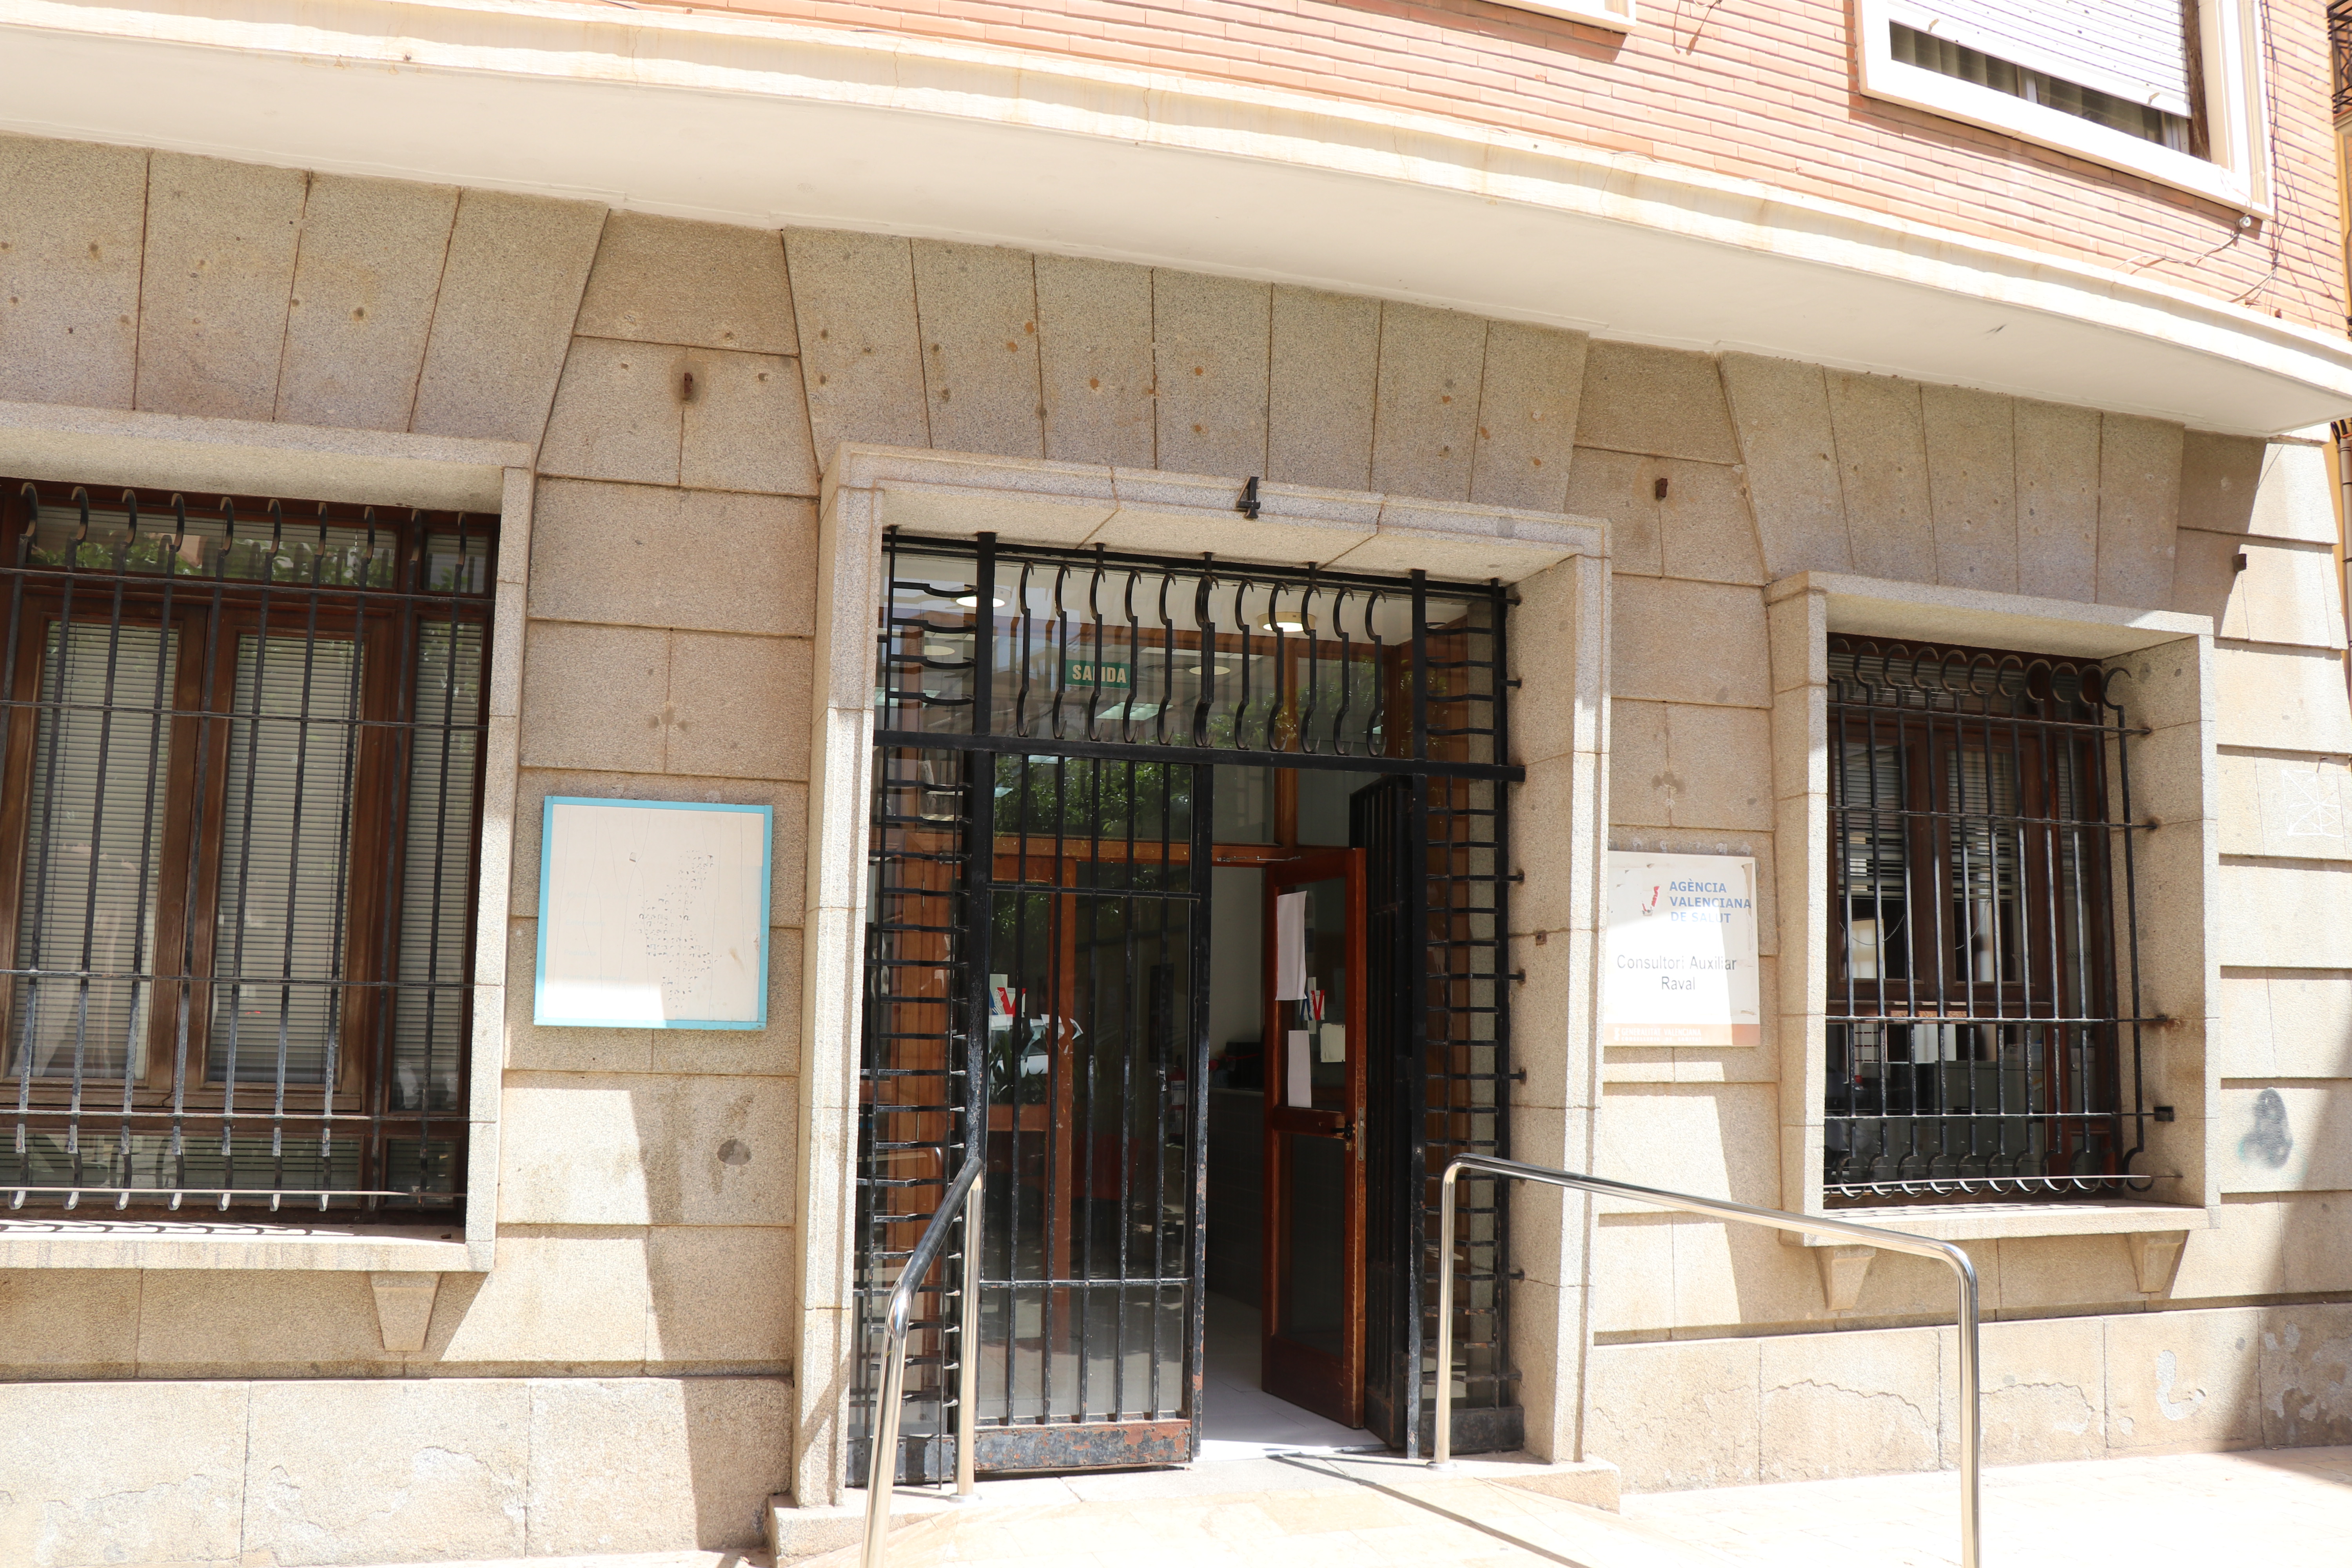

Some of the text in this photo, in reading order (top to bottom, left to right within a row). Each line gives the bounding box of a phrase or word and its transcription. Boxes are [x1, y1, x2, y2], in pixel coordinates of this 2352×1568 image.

[1072, 664, 1127, 683] SAIDA
[1669, 878, 1727, 893] AGÈNCIA
[1670, 897, 1751, 909] VALENCIANA
[1671, 911, 1731, 924] DE SALUT
[1617, 954, 1737, 971] Consultori Auxiliar
[1661, 976, 1696, 990] Raval
[1621, 1027, 1661, 1036] GENERALITAT
